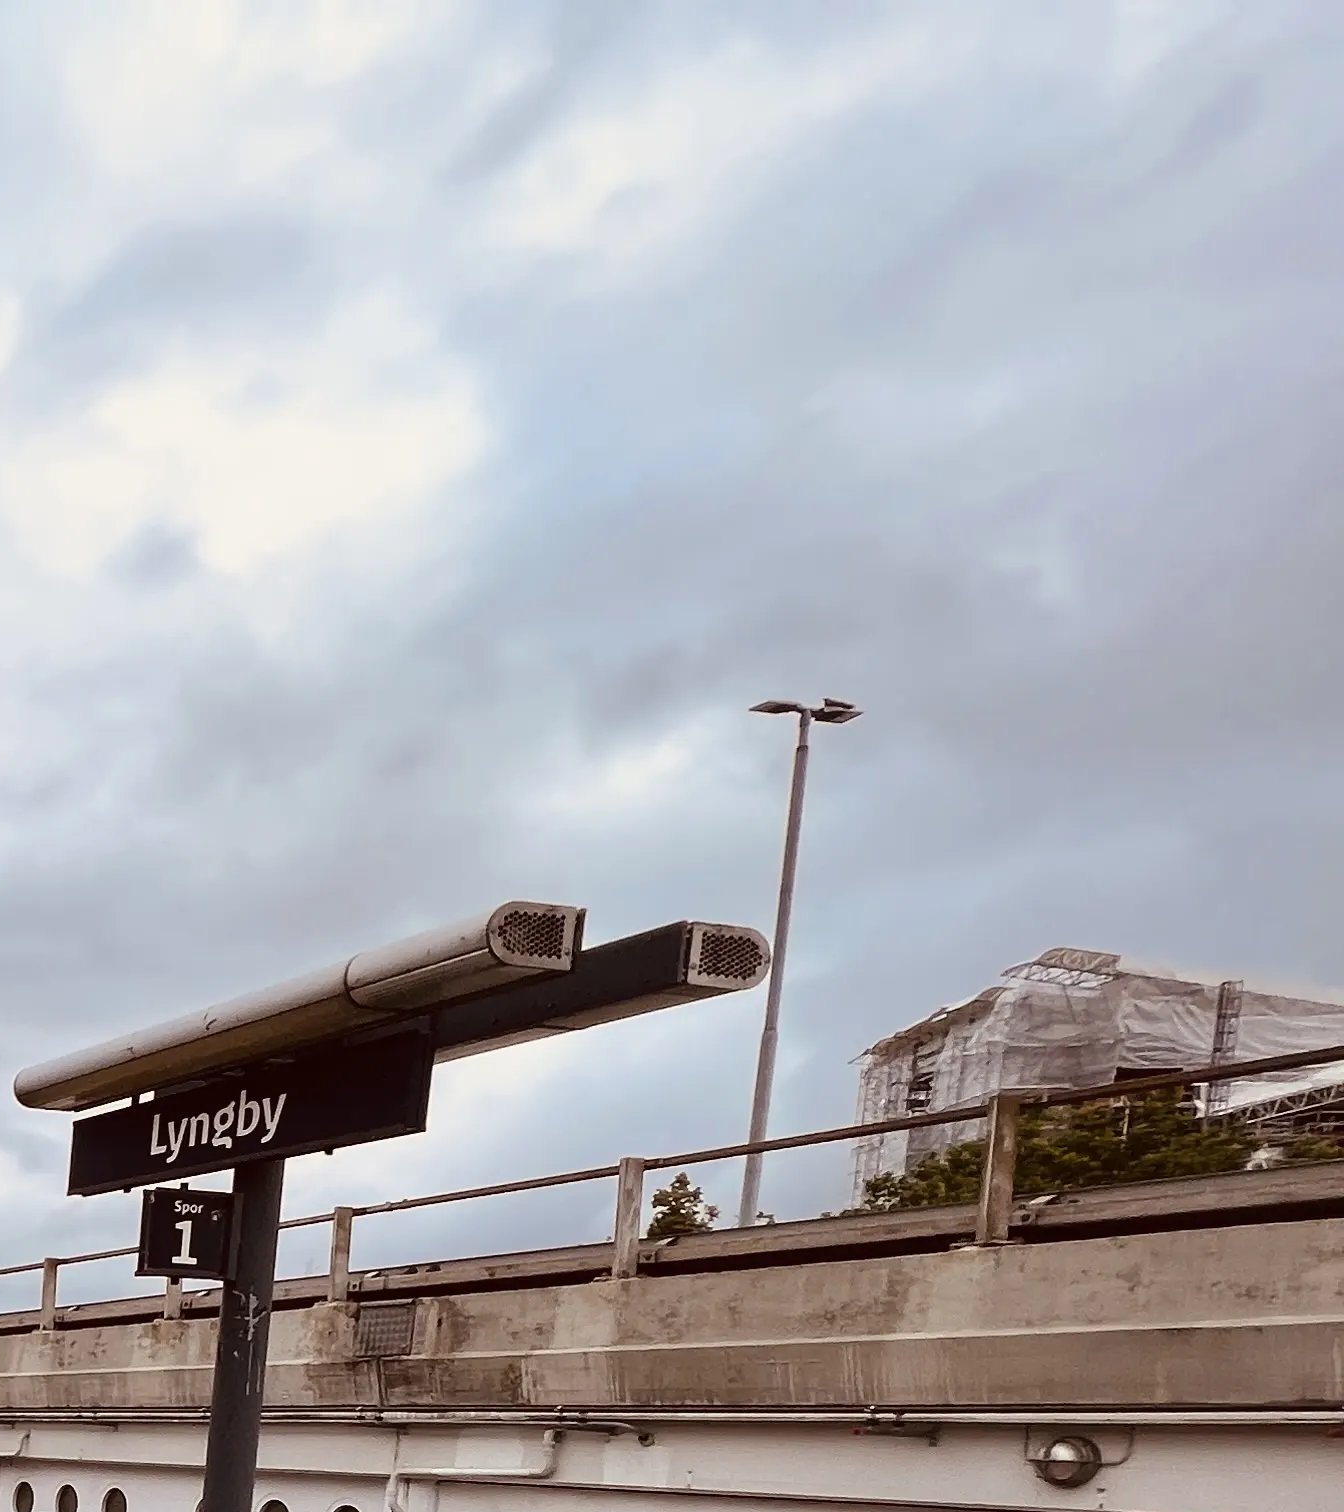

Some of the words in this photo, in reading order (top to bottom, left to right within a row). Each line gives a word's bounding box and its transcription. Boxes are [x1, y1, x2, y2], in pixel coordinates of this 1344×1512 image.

[150, 1089, 287, 1164] Lyngby
[174, 1200, 205, 1215] Spor
[171, 1220, 198, 1265] 1
